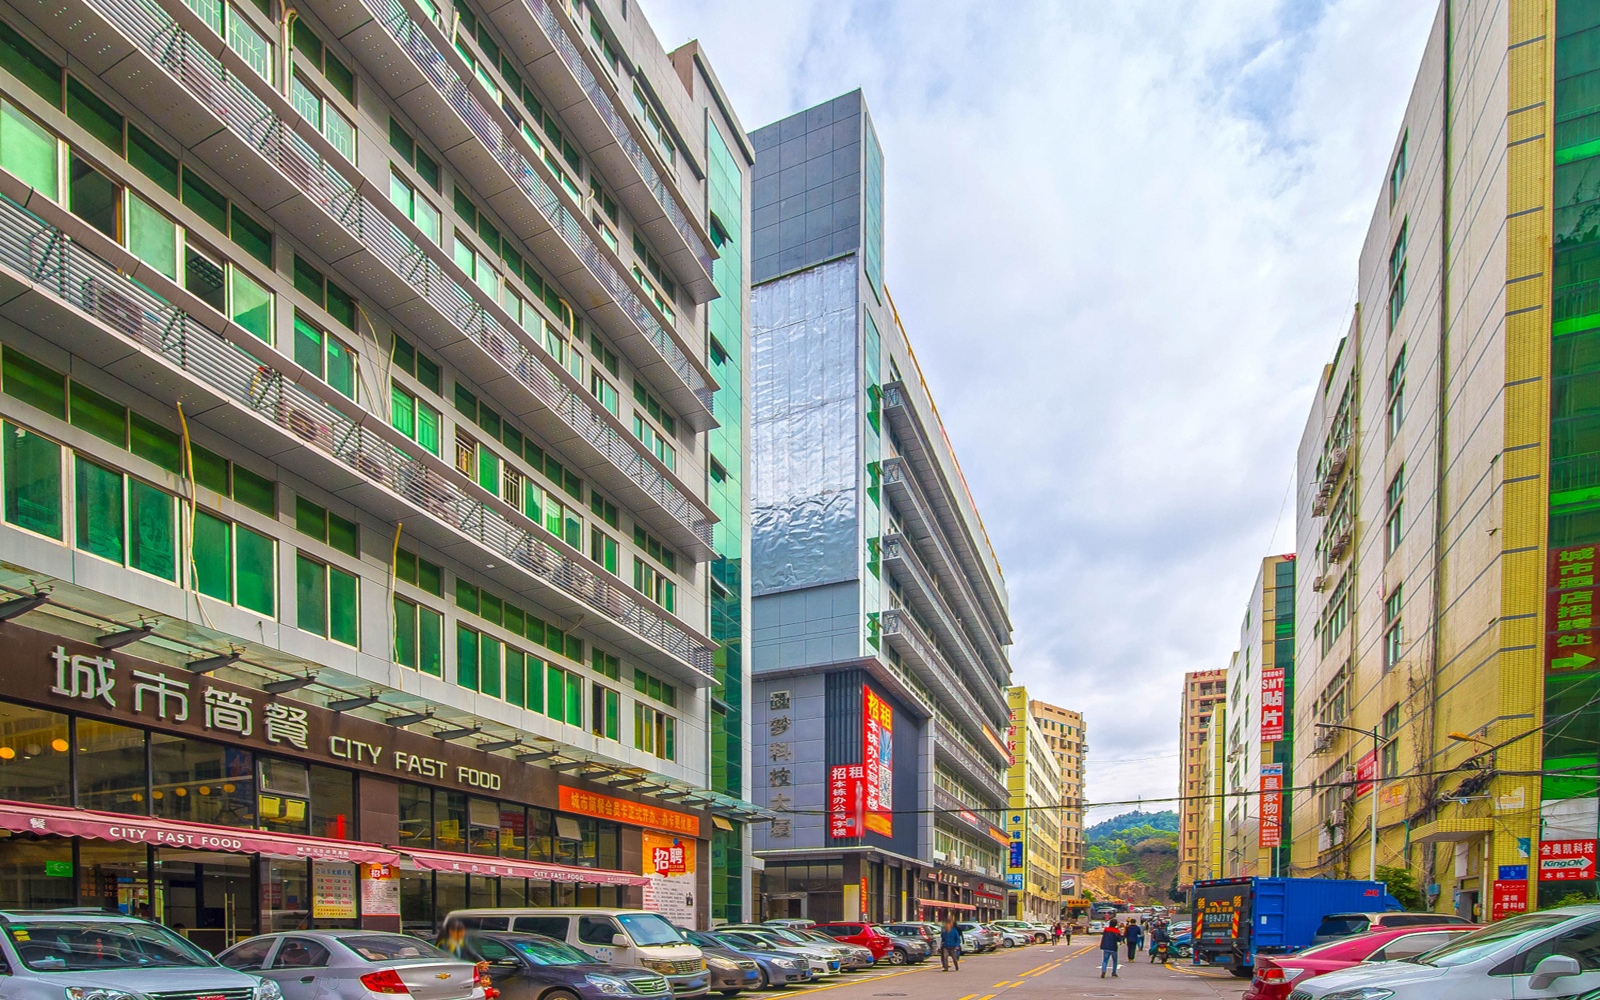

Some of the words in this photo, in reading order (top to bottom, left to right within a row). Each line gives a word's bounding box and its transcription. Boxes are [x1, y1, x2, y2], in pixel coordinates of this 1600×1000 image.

[1557, 547, 1595, 647] 城市酒店招聘处
[1262, 678, 1283, 690] SMT
[51, 645, 309, 749] 城市简餐
[868, 692, 892, 730] 招租
[1262, 691, 1282, 726] 贴片
[329, 736, 382, 764] CITY
[394, 751, 448, 779] FAST
[457, 766, 501, 791] FOOD
[832, 766, 864, 780] 招租
[109, 827, 147, 839] CITY
[157, 831, 194, 844] FAST
[201, 837, 242, 849] FOOD
[1542, 842, 1594, 855] 金奥凯科技
[654, 848, 683, 871] 招聘
[1543, 859, 1585, 868] KingOK
[371, 868, 389, 878] 招聘
[1502, 894, 1518, 902] 深圳
